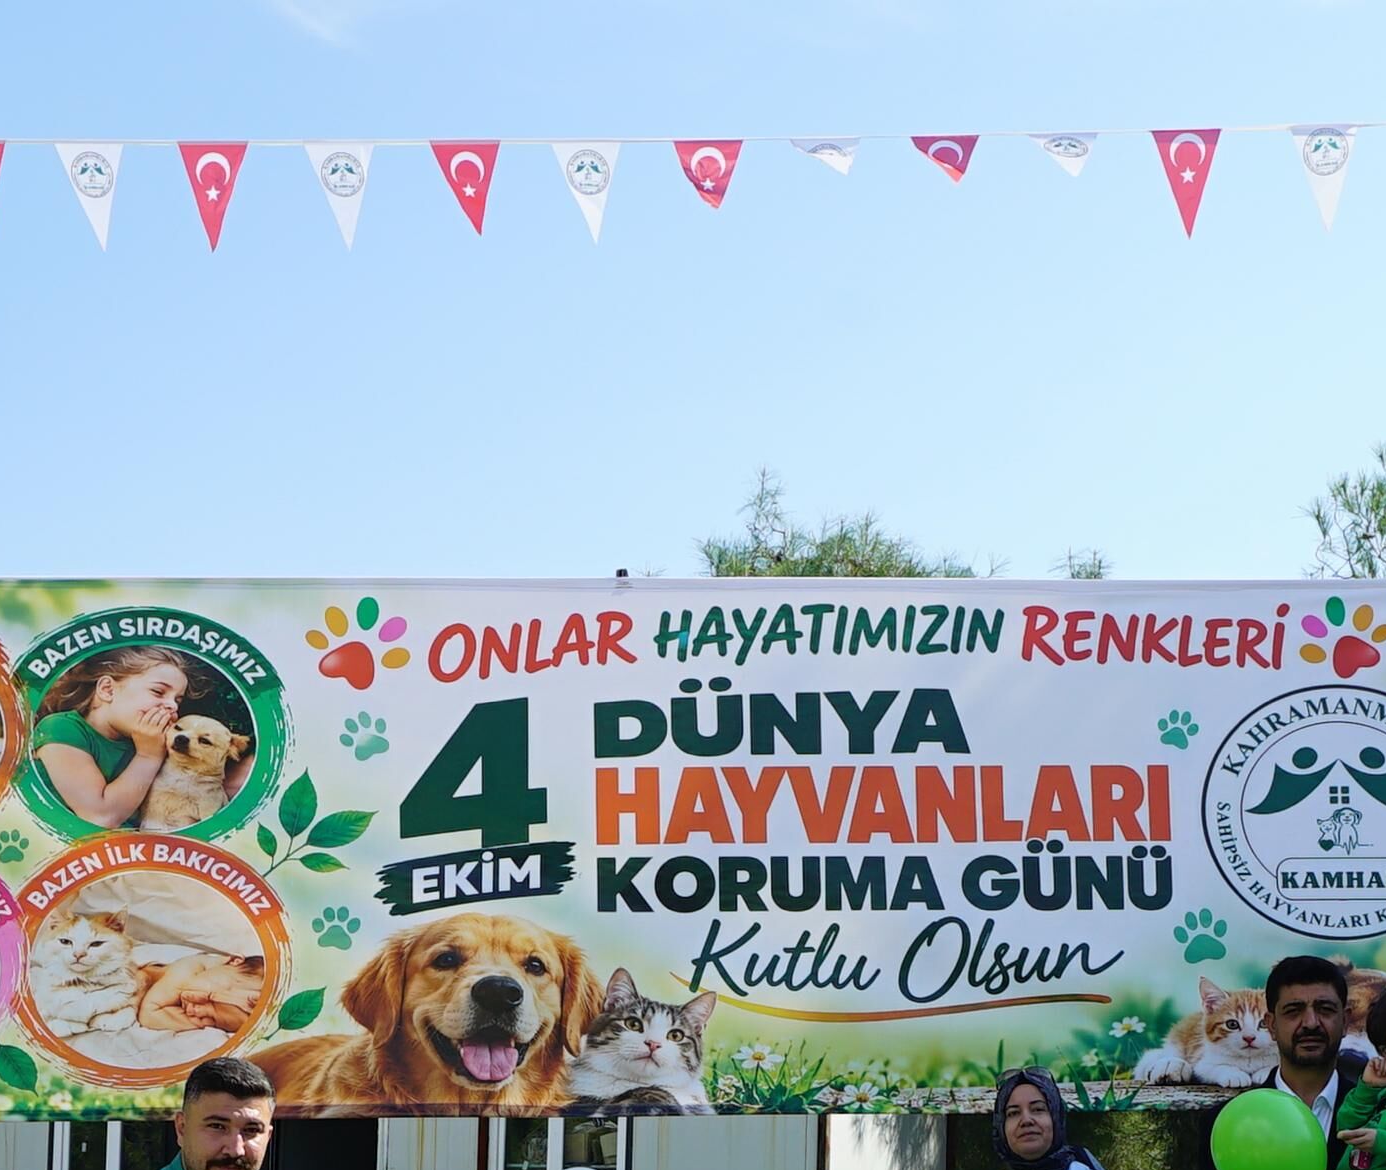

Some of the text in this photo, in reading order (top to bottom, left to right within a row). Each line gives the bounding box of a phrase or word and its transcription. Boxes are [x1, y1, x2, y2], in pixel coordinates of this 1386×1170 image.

[26, 615, 269, 686] BAZEN SIRDAŞIMIZ
[428, 602, 1291, 684] ONLAR HAYATIMIZIN RENKLERİ
[593, 675, 972, 759] DÜNYA
[399, 695, 549, 850] 4
[594, 763, 1174, 846] HAYVANLARI
[25, 836, 274, 917] BAZEN İLK BAKICIMIZ
[411, 849, 544, 907] EKİM
[596, 838, 1176, 915] KORUMA GÜNÜ
[1216, 800, 1250, 884] SAHİPSİZ
[1248, 879, 1371, 930] HAYVANLARI
[689, 915, 1125, 1003] Kutlu Olsun
